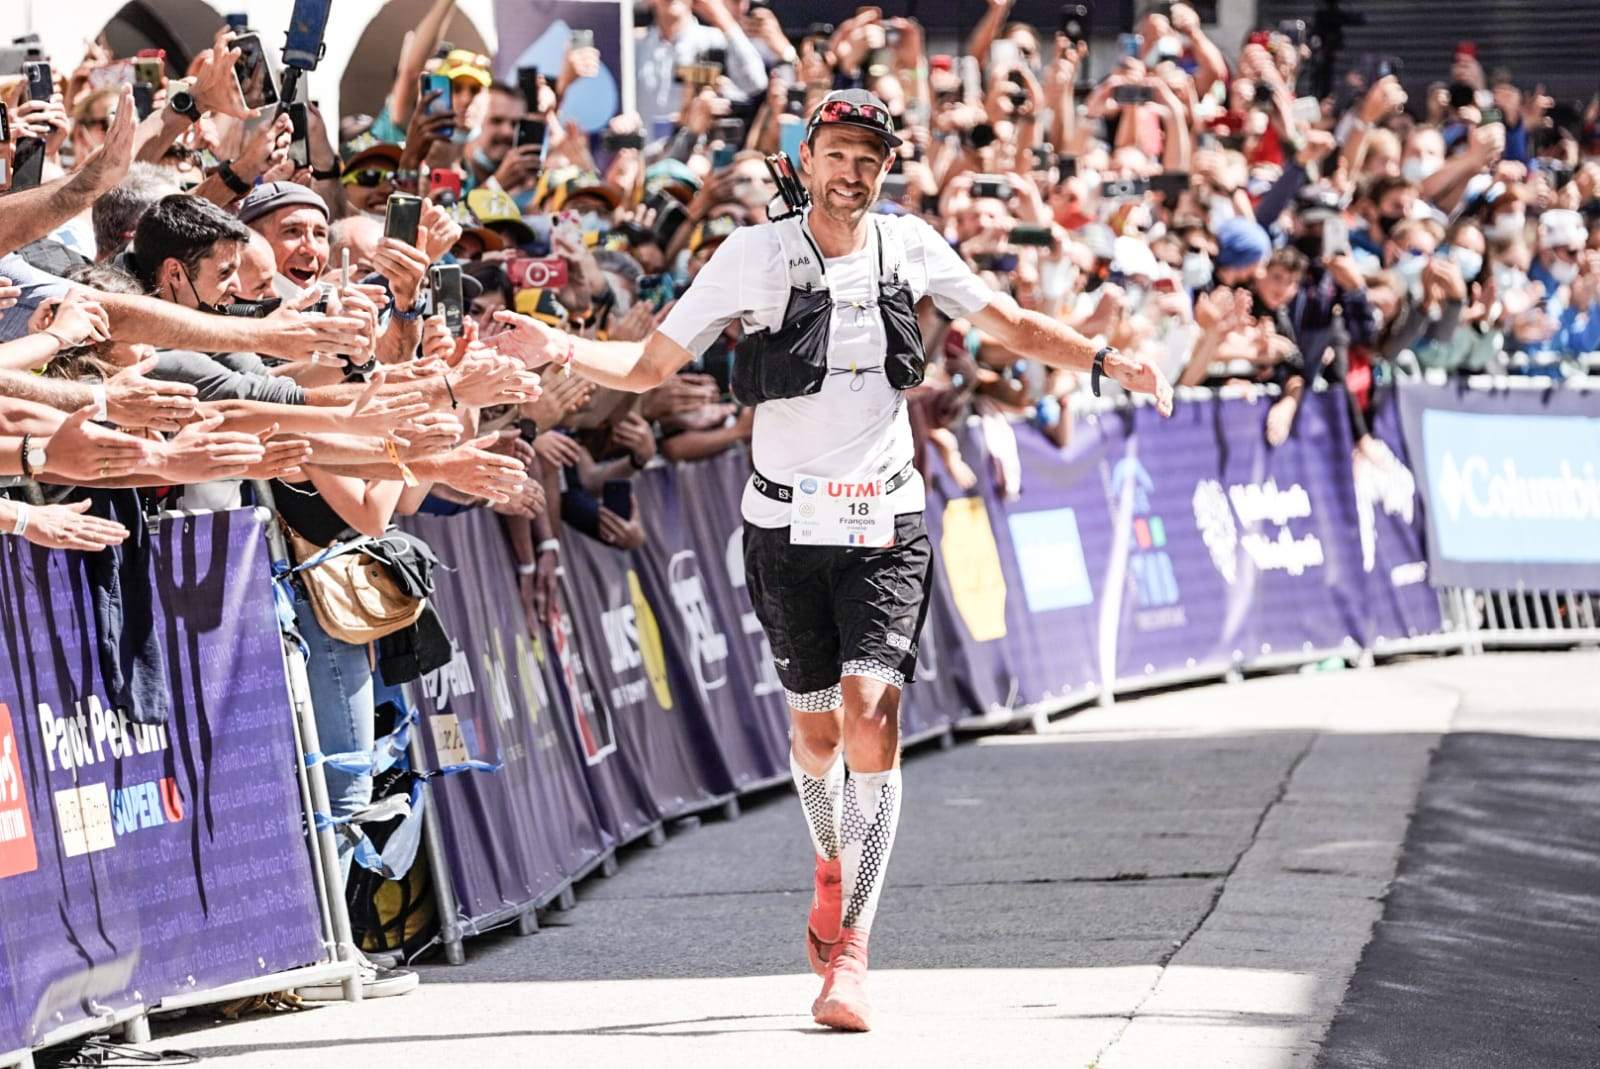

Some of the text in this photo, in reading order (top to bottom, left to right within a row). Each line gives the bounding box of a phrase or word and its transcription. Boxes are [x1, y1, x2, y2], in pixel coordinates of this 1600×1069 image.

[1461, 455, 1600, 520] Columbi
[839, 517, 876, 526] François
[848, 502, 870, 516] 18
[110, 781, 165, 836] SUPER
[160, 776, 184, 823] U
